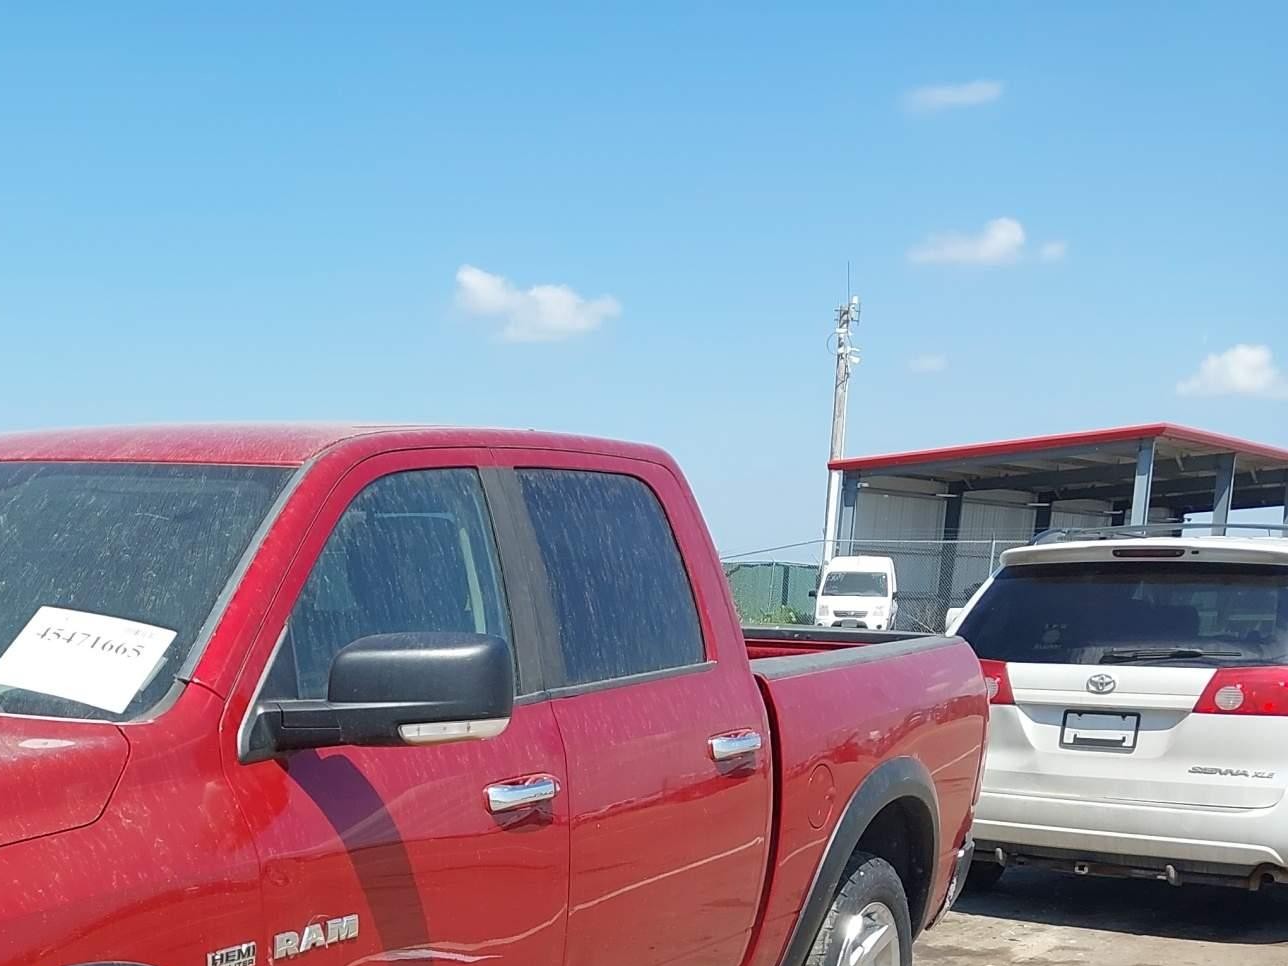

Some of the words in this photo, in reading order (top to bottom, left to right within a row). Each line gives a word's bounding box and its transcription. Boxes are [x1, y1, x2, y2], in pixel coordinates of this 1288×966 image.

[37, 627, 145, 657] 45471665
[1188, 766, 1249, 777] SIENNA
[274, 914, 359, 959] RAM
[211, 944, 256, 966] HEMI
